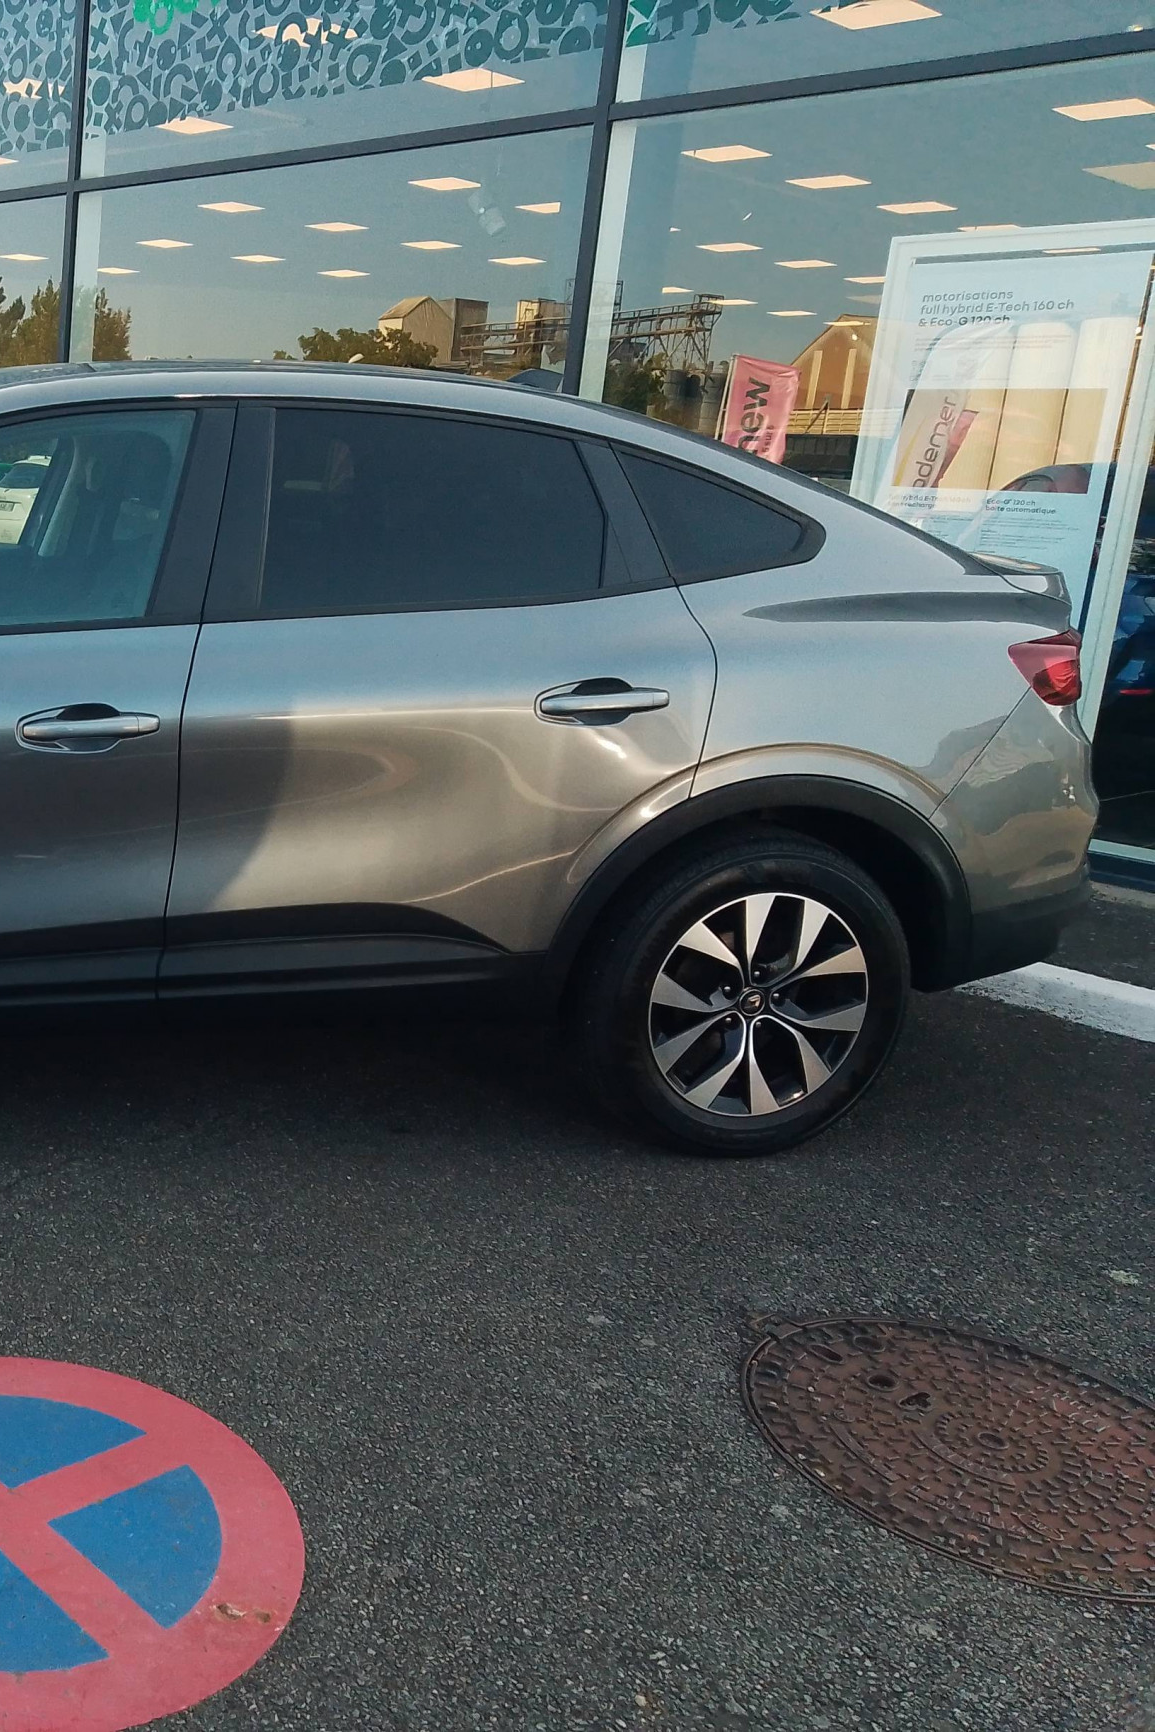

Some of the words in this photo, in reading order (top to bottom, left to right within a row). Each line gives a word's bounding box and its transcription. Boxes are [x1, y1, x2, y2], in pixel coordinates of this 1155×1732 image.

[922, 290, 1014, 302] motorisations
[920, 304, 941, 315] full
[941, 302, 985, 316] hybrid
[985, 300, 1031, 313] E-Tech
[1032, 300, 1055, 312] 160
[1057, 298, 1075, 310] ch
[1006, 507, 1057, 515] automatique
